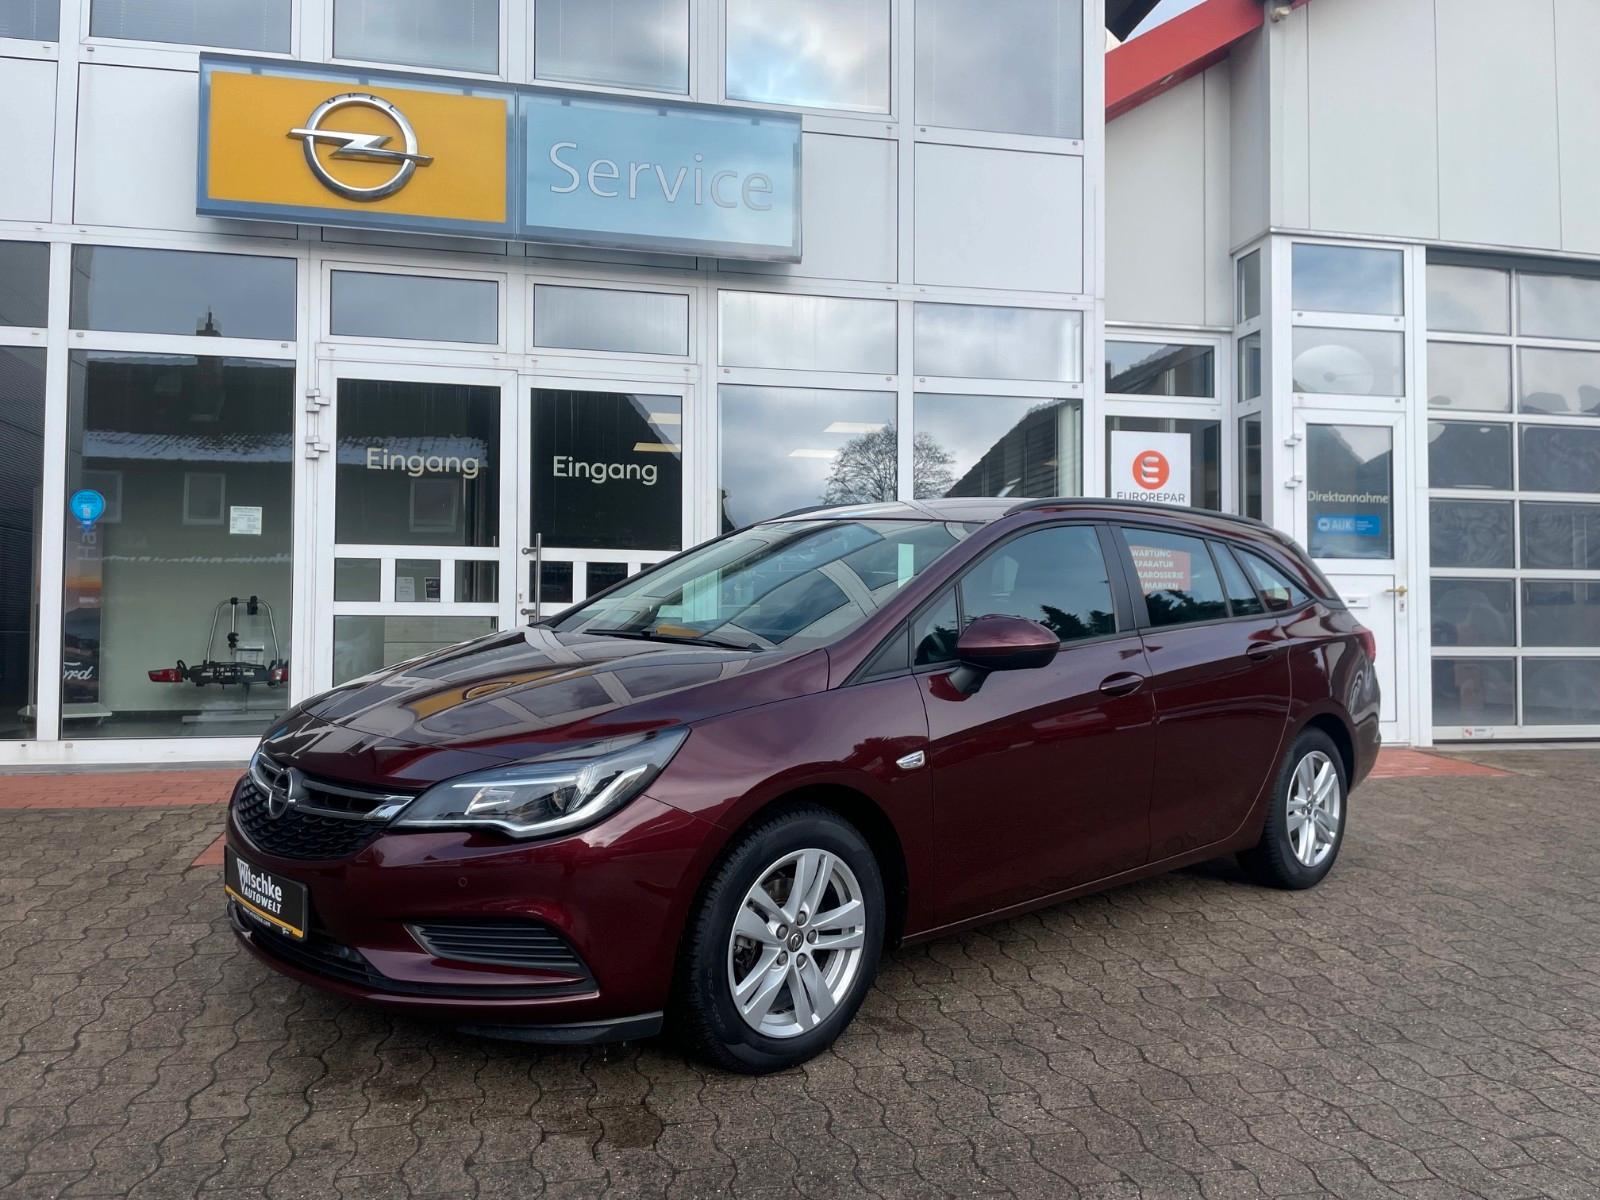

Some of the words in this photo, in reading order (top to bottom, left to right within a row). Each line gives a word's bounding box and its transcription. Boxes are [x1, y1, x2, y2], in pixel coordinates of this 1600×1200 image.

[549, 141, 774, 211] Service
[366, 447, 479, 479] Eingang
[553, 455, 658, 485] Eingang
[1116, 491, 1186, 503] EUROREPAR
[1307, 490, 1389, 504] Direktannahme
[1131, 549, 1172, 558] WARTUNG
[1134, 559, 1174, 568] EPARATUR
[237, 857, 283, 901] Witschke
[244, 886, 283, 914] AUTOWELT
